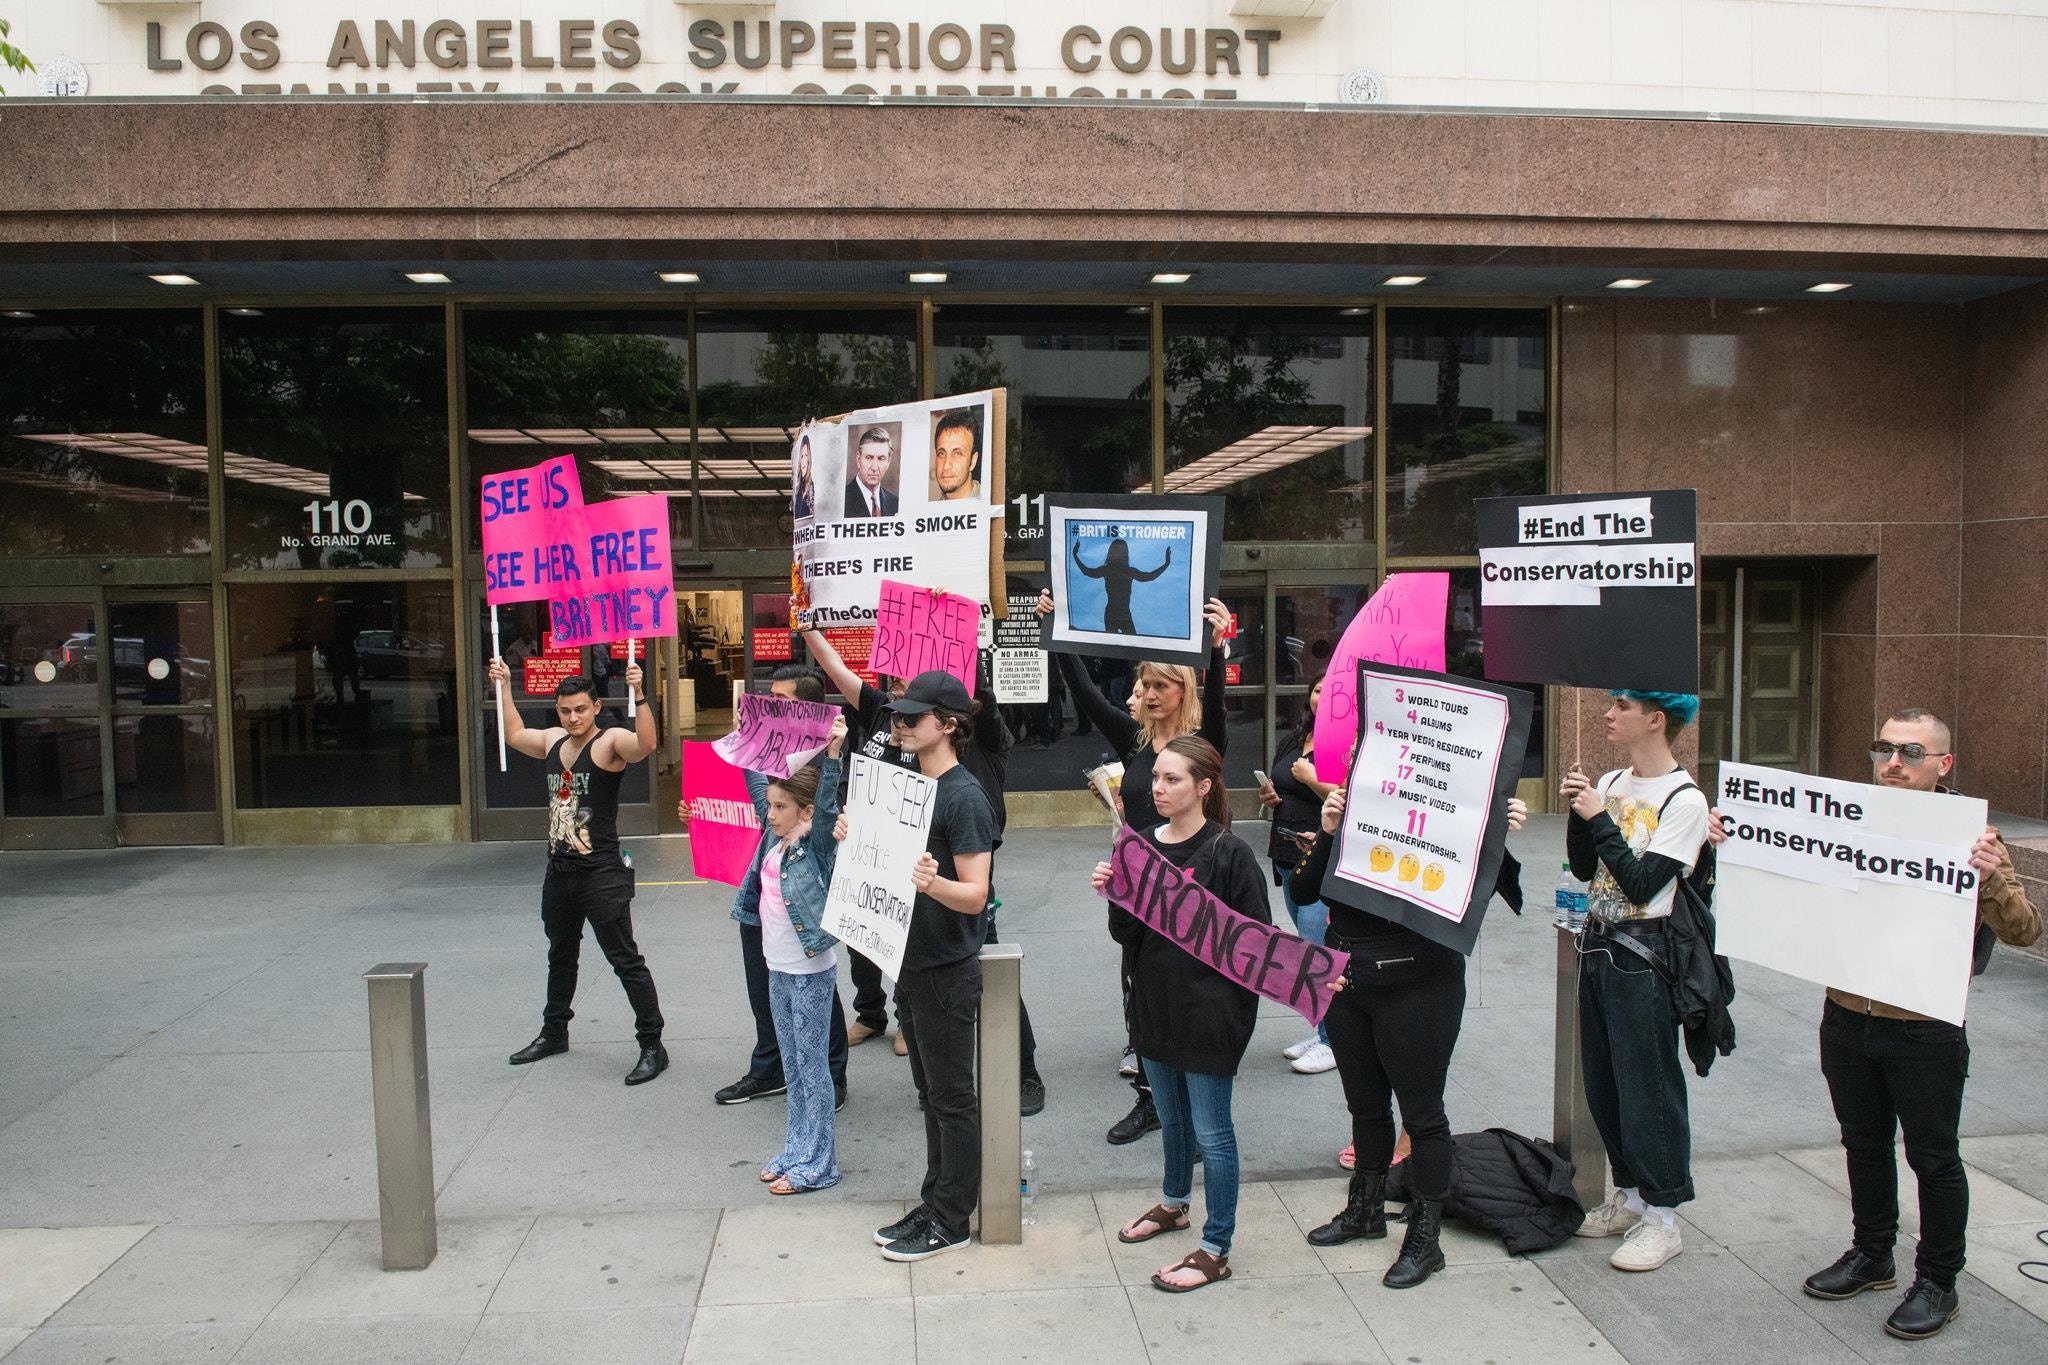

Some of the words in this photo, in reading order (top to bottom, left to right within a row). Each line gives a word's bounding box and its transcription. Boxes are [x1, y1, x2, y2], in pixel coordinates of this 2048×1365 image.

[147, 19, 280, 71] LOS
[326, 19, 641, 70] ANGELES
[687, 19, 1016, 72] SUPERIOR
[1060, 24, 1281, 76] COURT
[484, 477, 530, 522] SEE
[540, 466, 569, 508] US
[1012, 494, 1044, 525] 11
[304, 499, 372, 534] 110
[831, 522, 904, 538] THERE'S
[915, 514, 977, 533] SMOKE
[1018, 528, 1044, 538] GRA
[1072, 525, 1186, 540] #BRITISSTRONGER
[1524, 515, 1584, 539] #End
[1594, 513, 1646, 536] The
[281, 536, 304, 547] No.
[311, 535, 360, 546] GRAND
[366, 534, 396, 545] AVE.
[485, 552, 525, 592] SEE
[534, 544, 580, 584] HER
[590, 528, 662, 577] FREE
[804, 559, 862, 578] THERE'S
[873, 556, 912, 573] FIRE
[1482, 557, 1694, 584] Conservatorship
[552, 585, 669, 641] BRITNEY
[882, 589, 968, 644] #FREE
[1009, 596, 1040, 604] WEAPON
[874, 626, 974, 684] BRITNEY
[1395, 688, 1404, 703] 3
[1408, 696, 1438, 708] WORLD
[1440, 702, 1468, 715] TOURS
[1407, 710, 1417, 724] 4
[1420, 717, 1452, 732] ALBUMS
[1375, 721, 1384, 735] 4
[1387, 728, 1409, 740] YEAR
[1436, 741, 1482, 759] RESIDENCY
[1400, 745, 1410, 759] 7
[1410, 753, 1450, 772] PERFUMES
[1397, 764, 1414, 780] 17
[1416, 774, 1448, 791] SINGLES
[868, 763, 880, 805] U
[887, 771, 934, 830] SEEK
[1381, 780, 1396, 795] 19
[1399, 790, 1427, 804] MUSIC
[1429, 798, 1456, 813] VIDEOS
[1725, 776, 1796, 809] #End
[1805, 789, 1863, 821] The
[690, 797, 760, 830] #FREEBRITNE
[1407, 809, 1426, 838] 11
[1357, 822, 1379, 835] YEAR
[1382, 829, 1461, 862] CONSERVATORSHIP...
[1720, 815, 1975, 894] Conservatorship
[1106, 834, 1334, 1021] STRONGER
